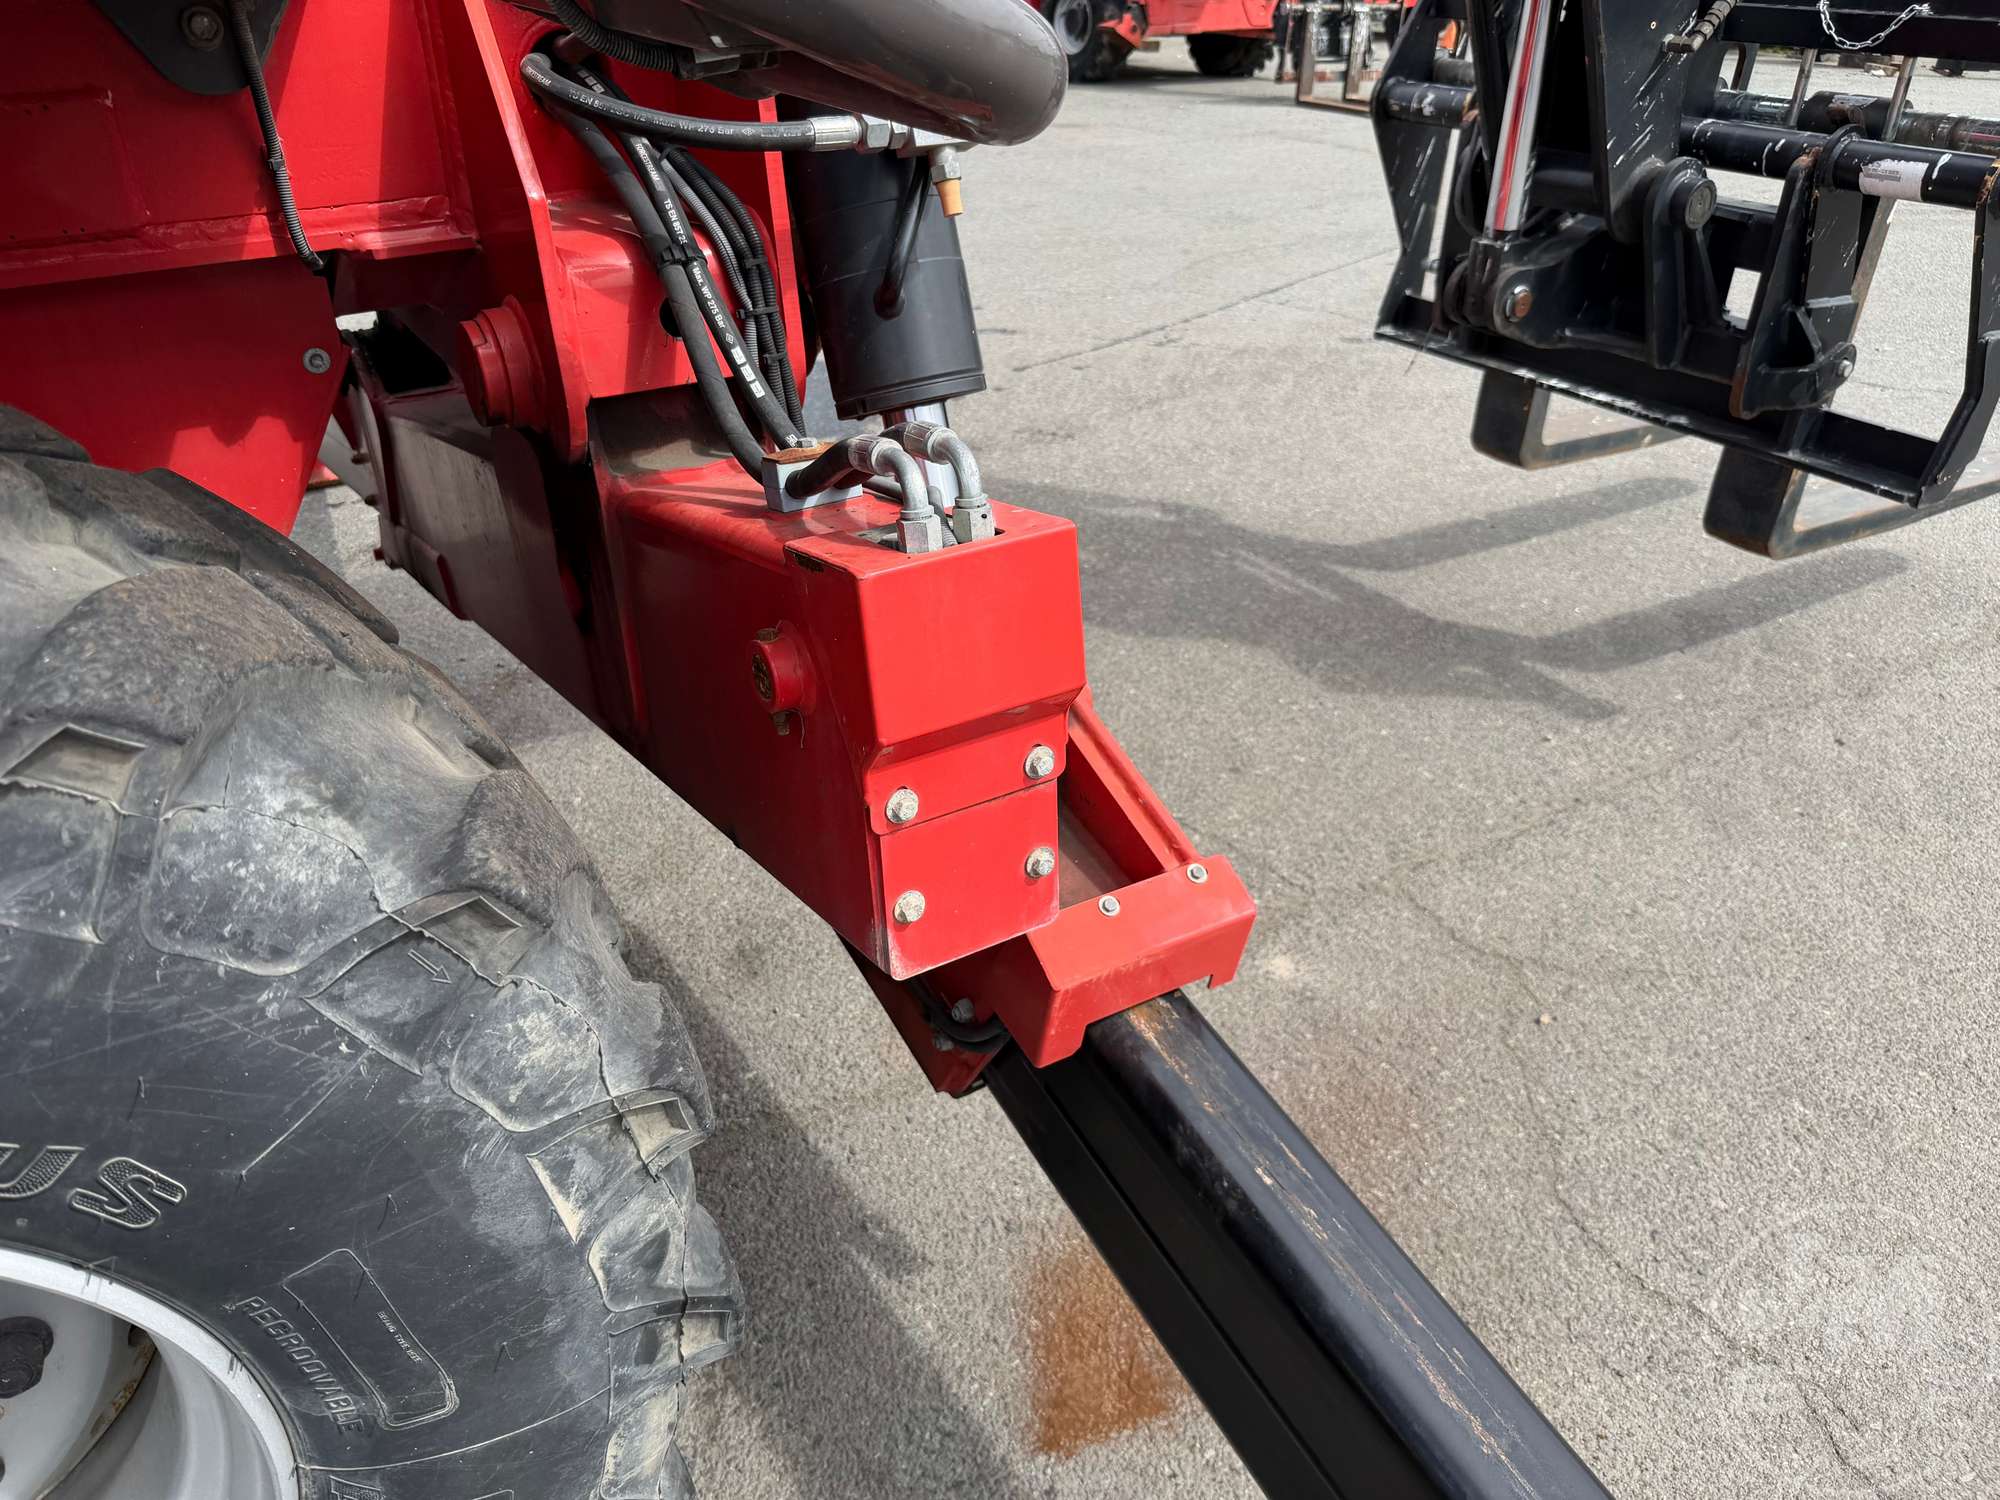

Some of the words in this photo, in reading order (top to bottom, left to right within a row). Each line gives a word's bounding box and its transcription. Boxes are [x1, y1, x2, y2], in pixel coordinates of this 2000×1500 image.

[580, 94, 593, 105] EN
[664, 198, 674, 210] TS
[668, 209, 678, 222] EN
[672, 221, 684, 235] 857
[692, 266, 703, 287] Max.
[701, 285, 713, 299] WP
[707, 299, 719, 315] 275
[715, 314, 725, 329] Bar
[235, 1295, 365, 1433] REGROOVABLE
